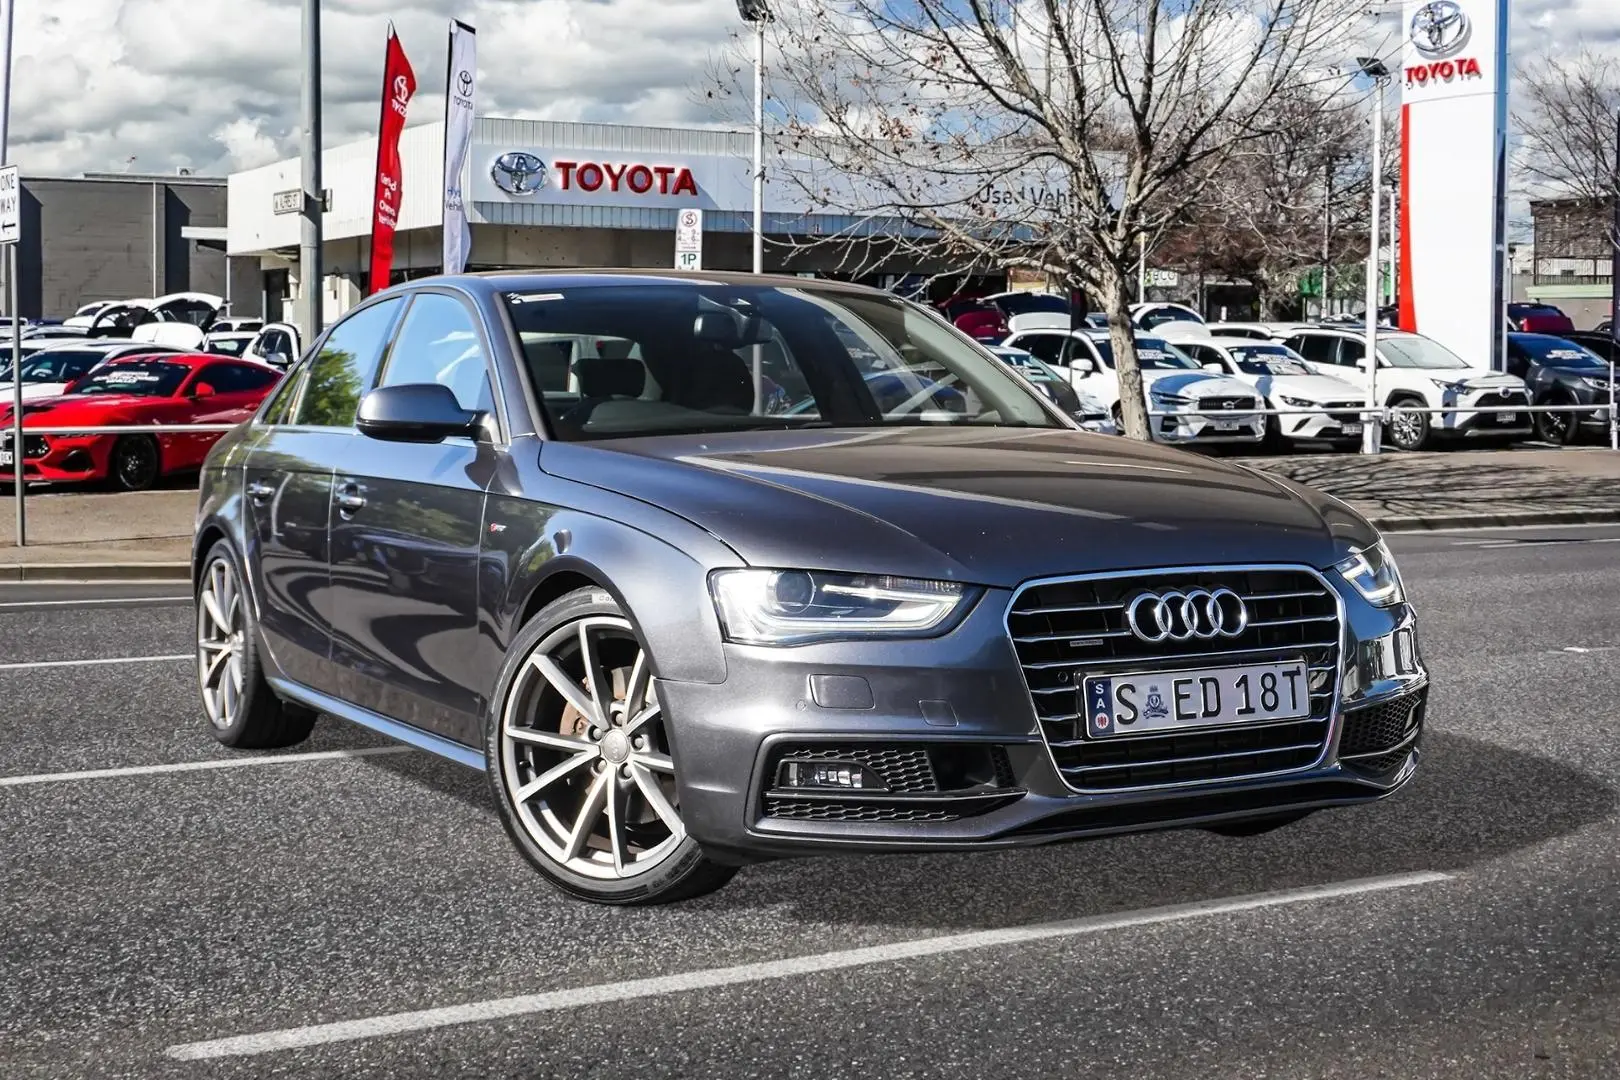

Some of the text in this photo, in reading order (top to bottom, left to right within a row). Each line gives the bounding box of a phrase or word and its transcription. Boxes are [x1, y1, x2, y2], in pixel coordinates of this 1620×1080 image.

[1404, 58, 1480, 82] TOYOTA
[1, 173, 15, 191] ONE
[555, 162, 698, 196] TOYOTA
[0, 196, 17, 215] WAY
[681, 253, 697, 265] 1P
